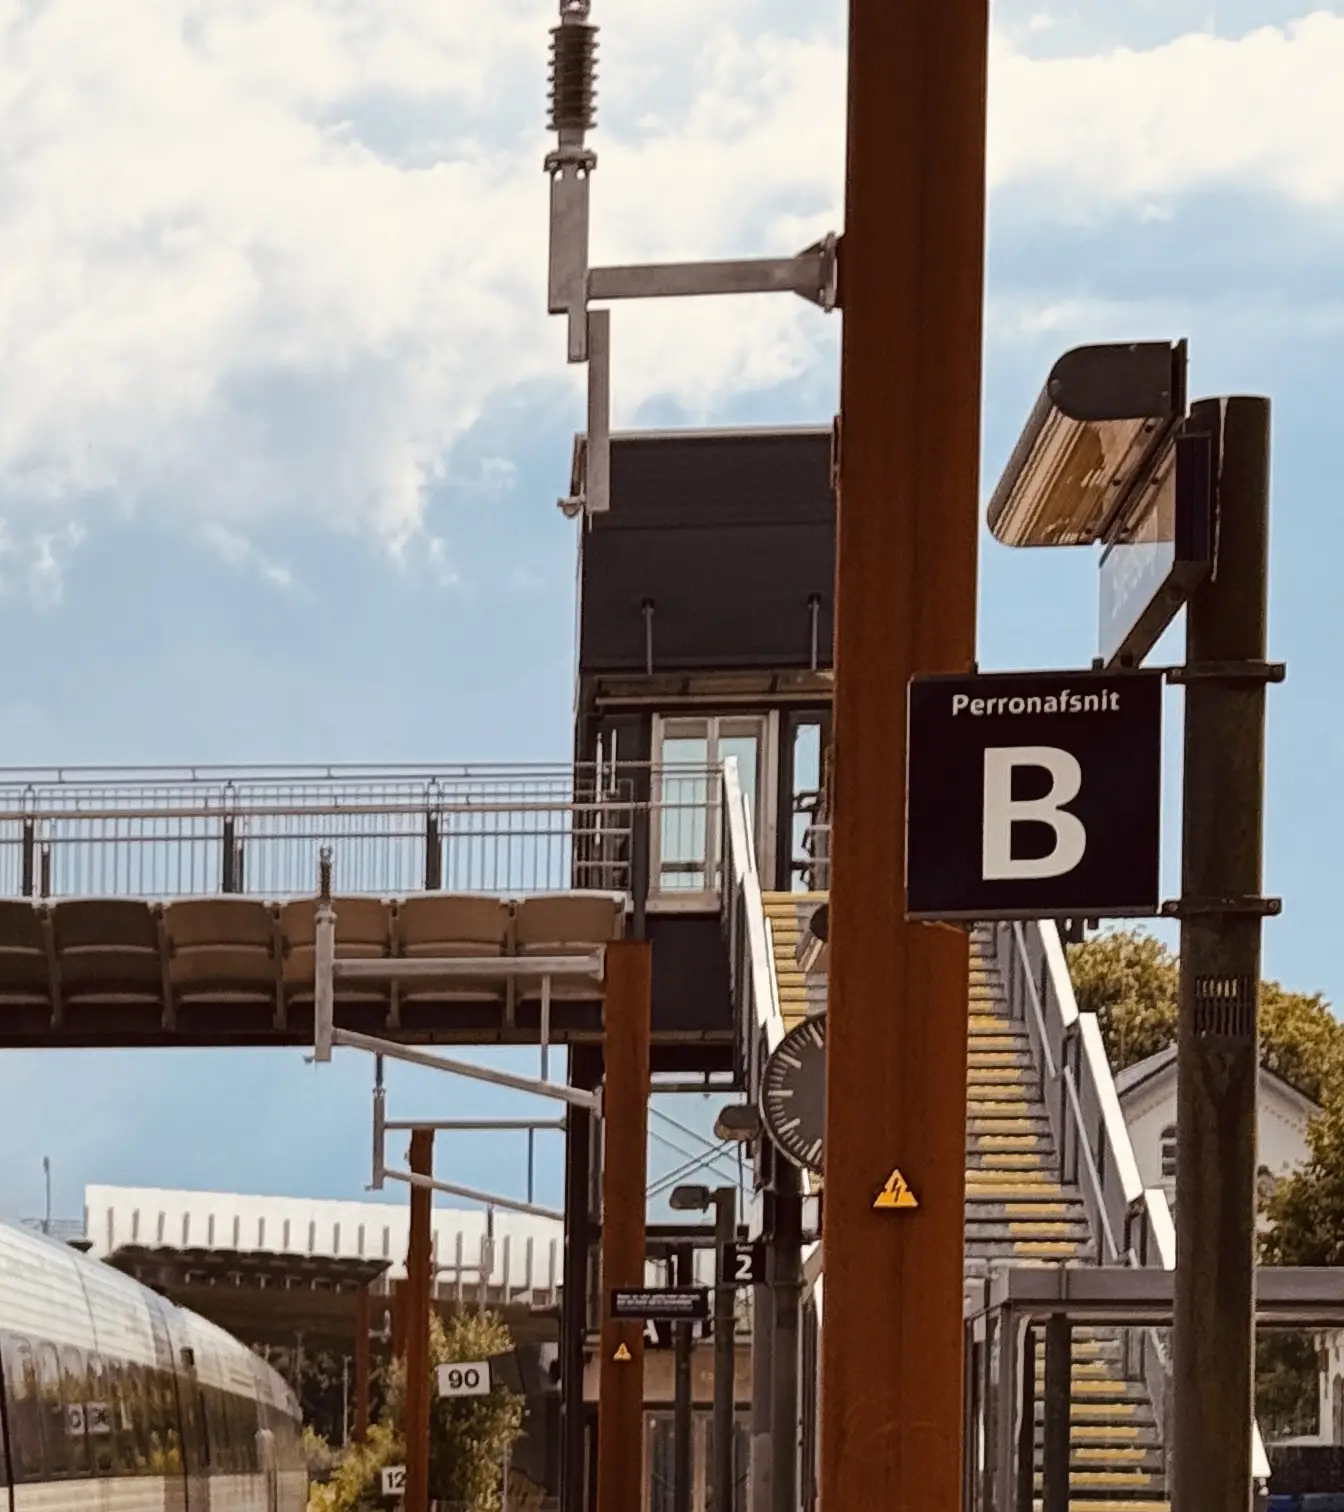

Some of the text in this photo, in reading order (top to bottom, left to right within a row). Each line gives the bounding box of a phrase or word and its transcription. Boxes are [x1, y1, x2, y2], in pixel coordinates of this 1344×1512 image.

[952, 688, 1120, 717] Perronafsnit
[982, 745, 1087, 881] B
[734, 1253, 753, 1281] 2
[448, 1368, 480, 1390] 90
